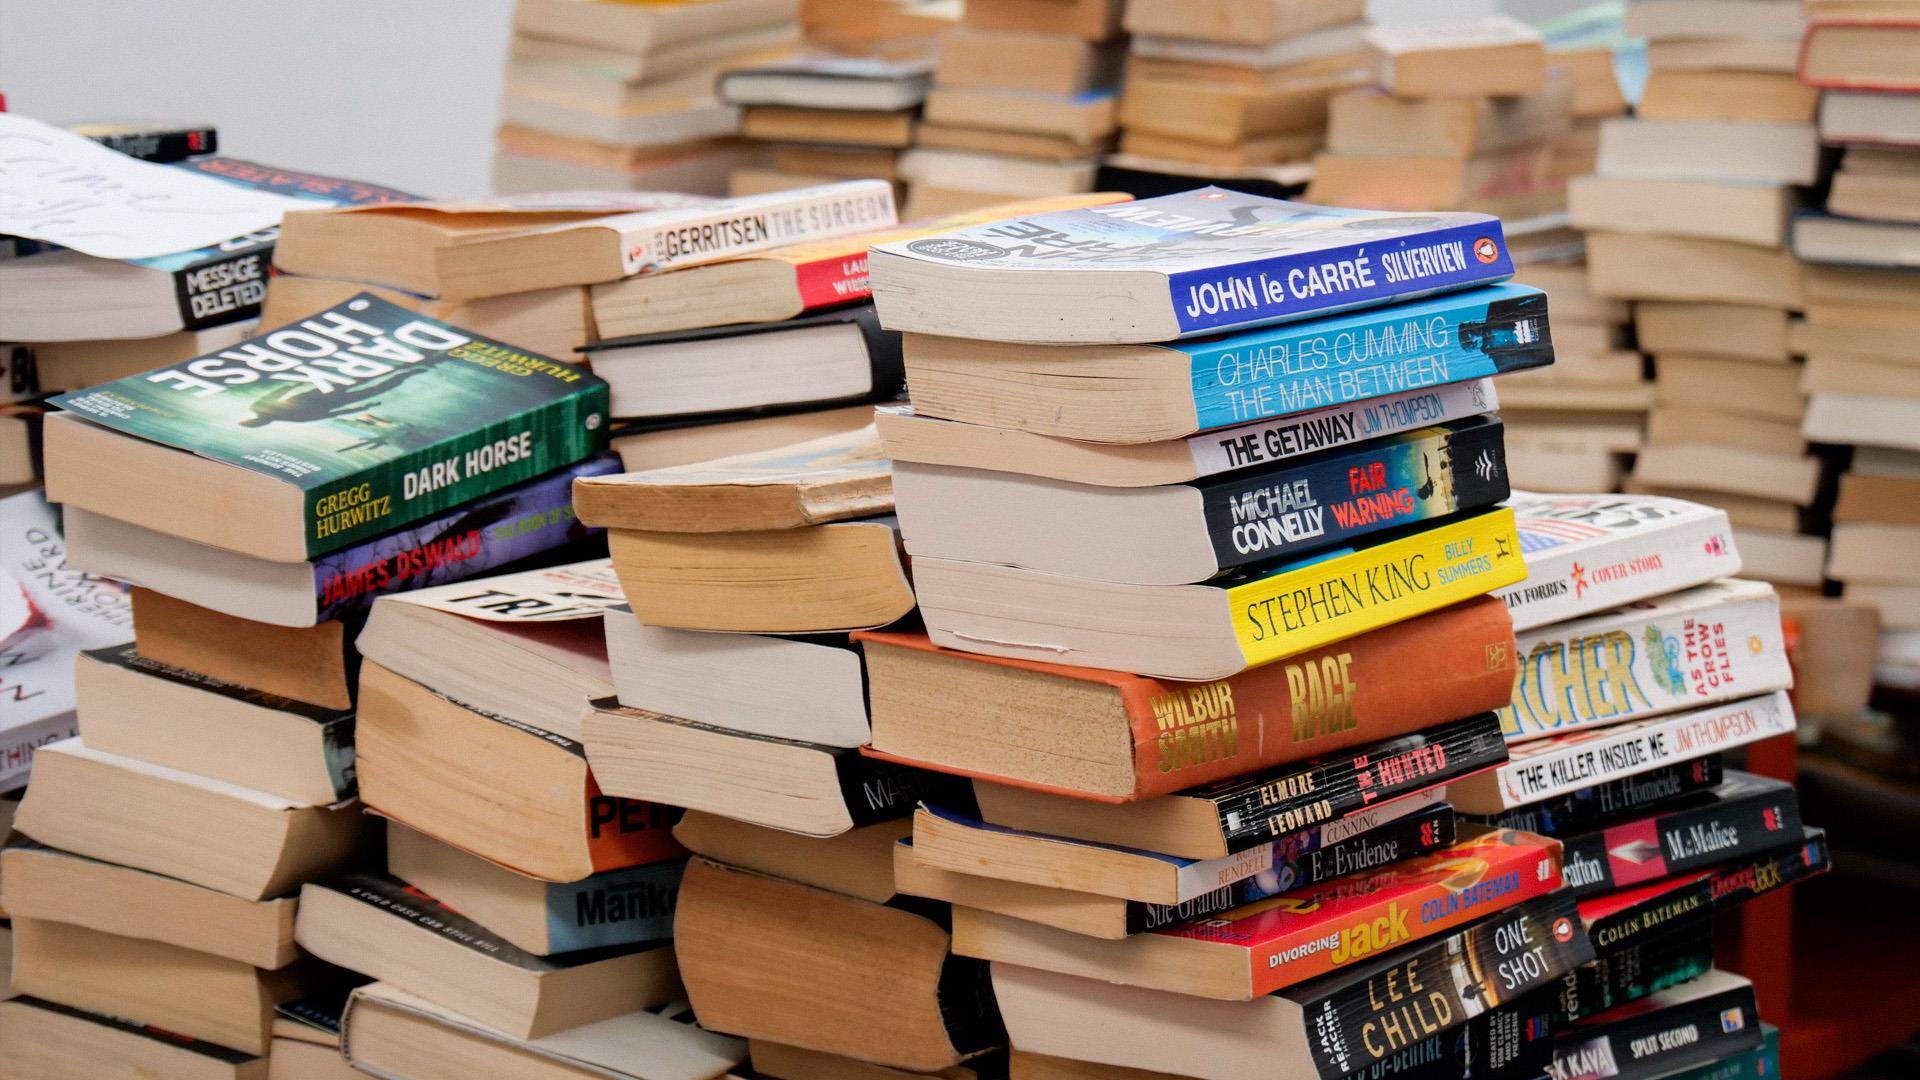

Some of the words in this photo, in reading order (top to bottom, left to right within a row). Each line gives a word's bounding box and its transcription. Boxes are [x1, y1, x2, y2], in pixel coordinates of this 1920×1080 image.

[666, 214, 768, 258] GERRITSEN
[772, 207, 805, 239] THE
[808, 192, 892, 231] SURGEON
[186, 255, 261, 296] MESSAGE
[843, 259, 868, 276] LAU
[1186, 277, 1258, 318] JOHN
[1263, 272, 1284, 304] le
[1288, 248, 1376, 299] CARRÉ
[1381, 240, 1467, 284] SILVERVIEW
[190, 280, 267, 319] DELETED
[146, 312, 384, 398] HORSE
[268, 320, 470, 394] DARK
[1217, 336, 1329, 387] CHARLES
[1336, 316, 1449, 366] CUMMING
[1225, 387, 1275, 421] THE
[1280, 376, 1334, 414] MAN
[1339, 355, 1449, 402] BETWEEN
[1220, 434, 1264, 467] THE
[1265, 412, 1357, 458] GETAWAY
[1362, 406, 1381, 436] JIM
[1379, 392, 1445, 430] THOMPSON
[403, 457, 460, 500] DARK
[465, 431, 531, 478] HORSE
[1349, 461, 1386, 496] FAIR
[316, 482, 370, 518] GREGG
[316, 496, 391, 539] HURWITZ
[1229, 478, 1317, 525] MICHAEL
[1330, 488, 1414, 529] WARNING
[1232, 507, 1325, 554] CONNELLY
[1444, 538, 1474, 561] BILLY
[323, 558, 389, 607] JAMES
[397, 529, 481, 581] OSWALD
[1437, 556, 1492, 585] SUMMERS
[1498, 589, 1522, 608] LIN
[1525, 580, 1567, 604] FORBES
[1591, 562, 1628, 585] COVER
[1630, 554, 1664, 576] STORY
[1247, 571, 1366, 641] STEPHEN
[1365, 554, 1431, 606] KING
[1684, 617, 1698, 662] THE
[1698, 623, 1719, 688] CROW
[1713, 622, 1734, 683] FLIES
[1151, 680, 1237, 731] WILBUR
[1285, 652, 1358, 745] RAGE
[1691, 667, 1708, 697] AS
[1157, 715, 1239, 773] SMITH
[1378, 743, 1447, 788] HUNTED
[1516, 769, 1548, 795] THE
[1549, 752, 1597, 788] KILLER
[1600, 739, 1647, 773] INSIDE
[1648, 733, 1669, 760] ME
[1672, 728, 1692, 754] JIM
[1690, 709, 1757, 749] THOMPSON
[1260, 770, 1316, 807] ELMORE
[1268, 799, 1332, 836] LEONARD
[1218, 855, 1265, 885] RENDELL
[1335, 838, 1398, 876] Evidence
[1562, 852, 1604, 888] rafton
[1666, 829, 1685, 861] M
[1689, 820, 1738, 855] Malice
[1421, 891, 1459, 924] COLIN
[1461, 870, 1521, 911] BATEMAN
[1599, 918, 1640, 946] COLIN
[1643, 895, 1699, 930] BATEMAN
[1495, 914, 1534, 956] ONE
[1368, 958, 1424, 1012] LEE
[1499, 945, 1551, 990] SHOT
[1562, 970, 1580, 1022] rend
[1315, 1014, 1332, 1055] JACK
[1323, 1000, 1350, 1073] REACHER
[1332, 1008, 1351, 1059] THRILLER
[1361, 991, 1453, 1060] CHILD
[1489, 1027, 1497, 1069] CREATED
[1496, 1011, 1504, 1046] CLANCY
[1630, 1035, 1659, 1060] SPLIT
[1658, 1024, 1700, 1051] SECOND
[1567, 1047, 1610, 1077] KAVA
